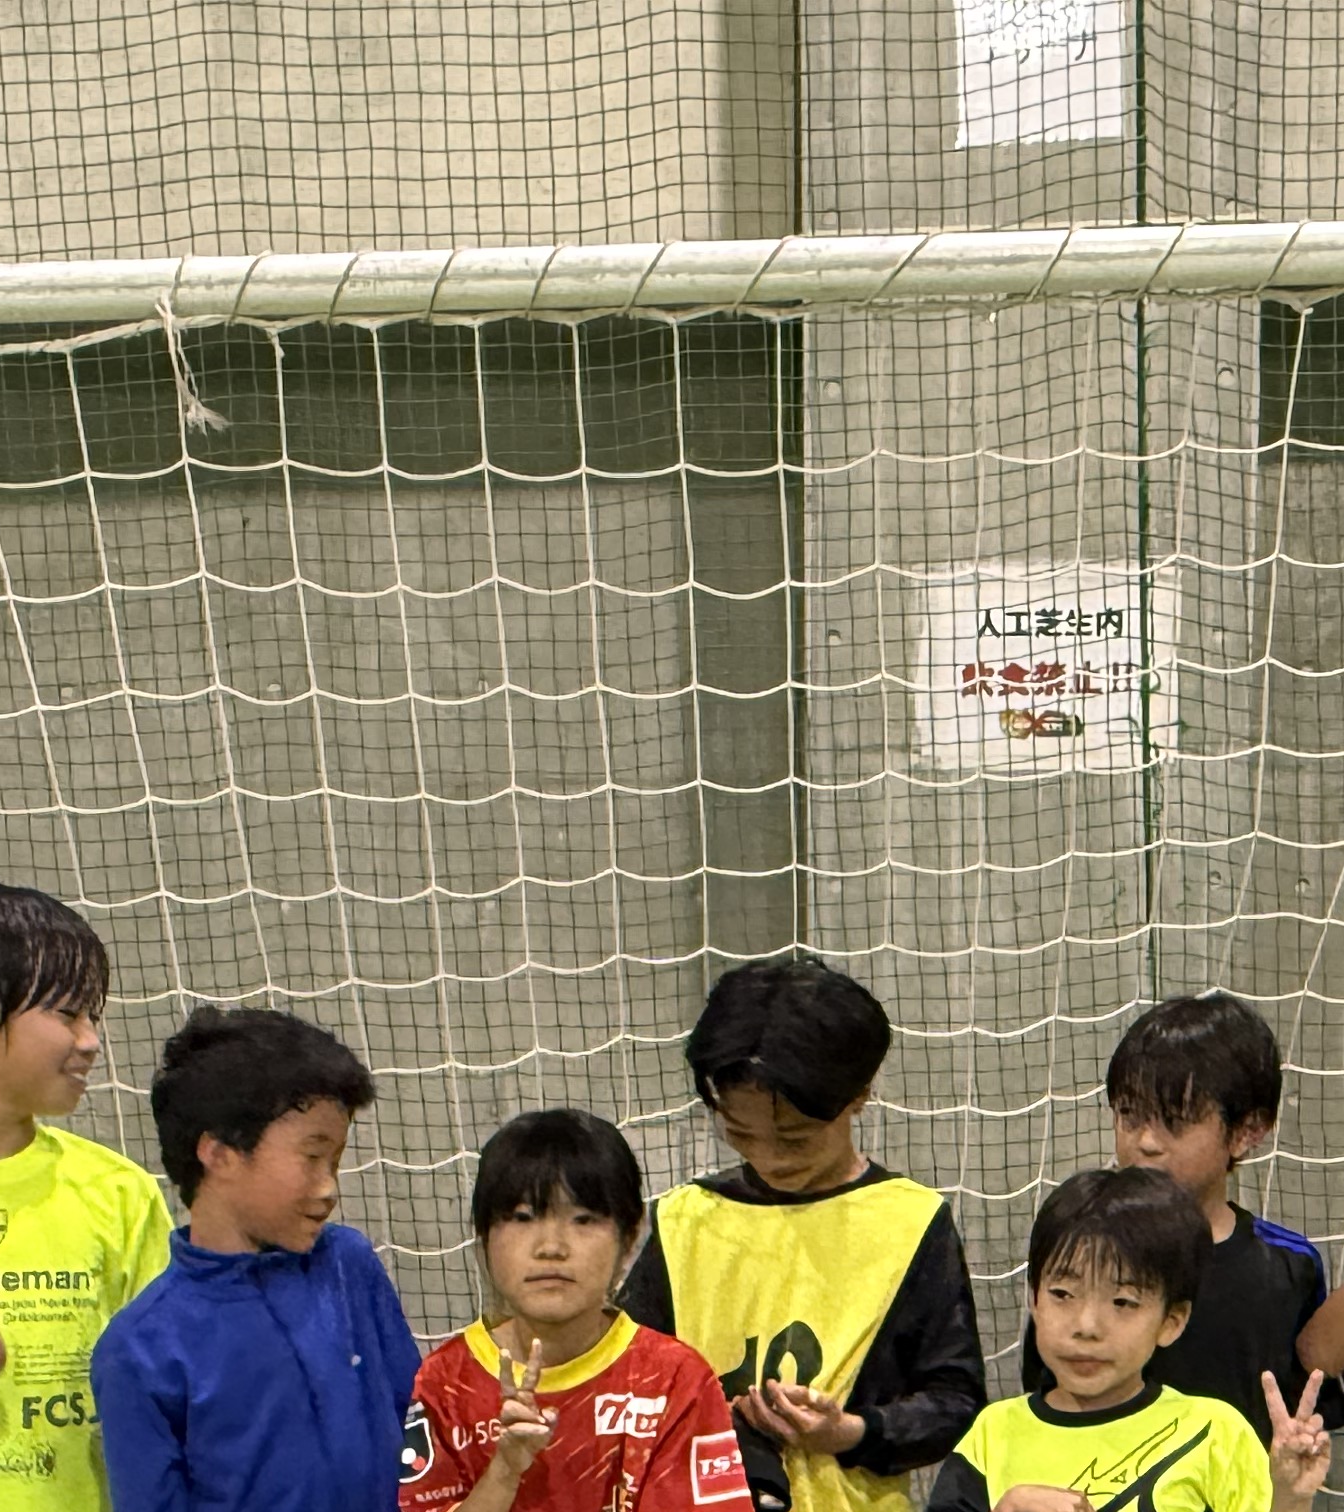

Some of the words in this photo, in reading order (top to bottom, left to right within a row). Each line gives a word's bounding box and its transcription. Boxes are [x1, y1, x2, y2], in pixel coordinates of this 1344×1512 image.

[977, 608, 1124, 639] 人工芝生内
